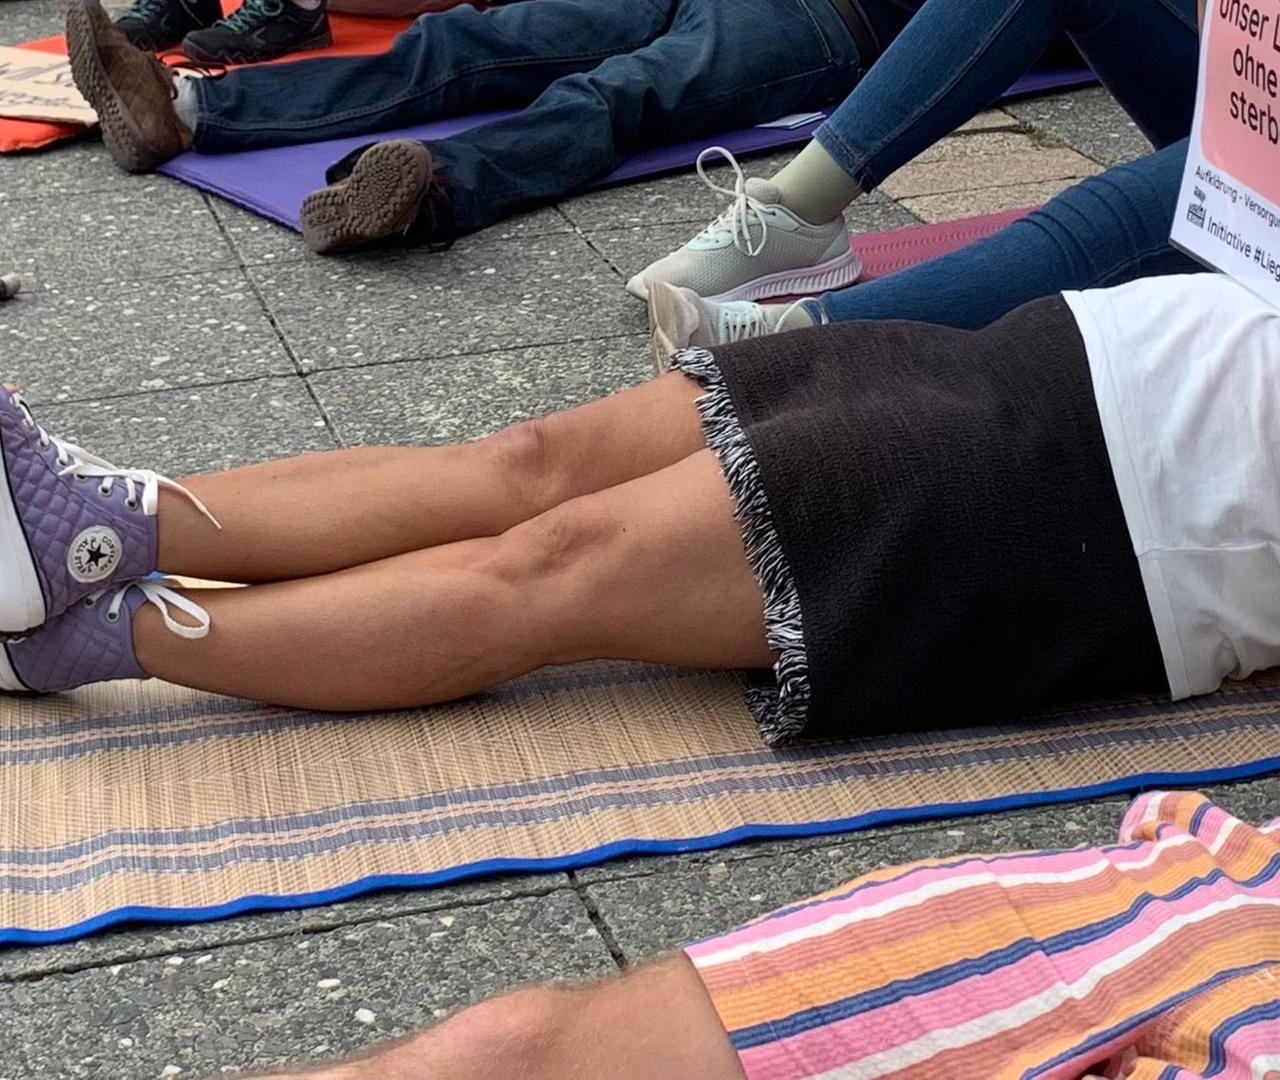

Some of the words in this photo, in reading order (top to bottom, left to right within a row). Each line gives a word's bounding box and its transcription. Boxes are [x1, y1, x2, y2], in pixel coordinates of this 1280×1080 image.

[1233, 44, 1278, 98] ohne
[1195, 165, 1237, 204] Aufklärung
[1207, 217, 1251, 258] Initiative
